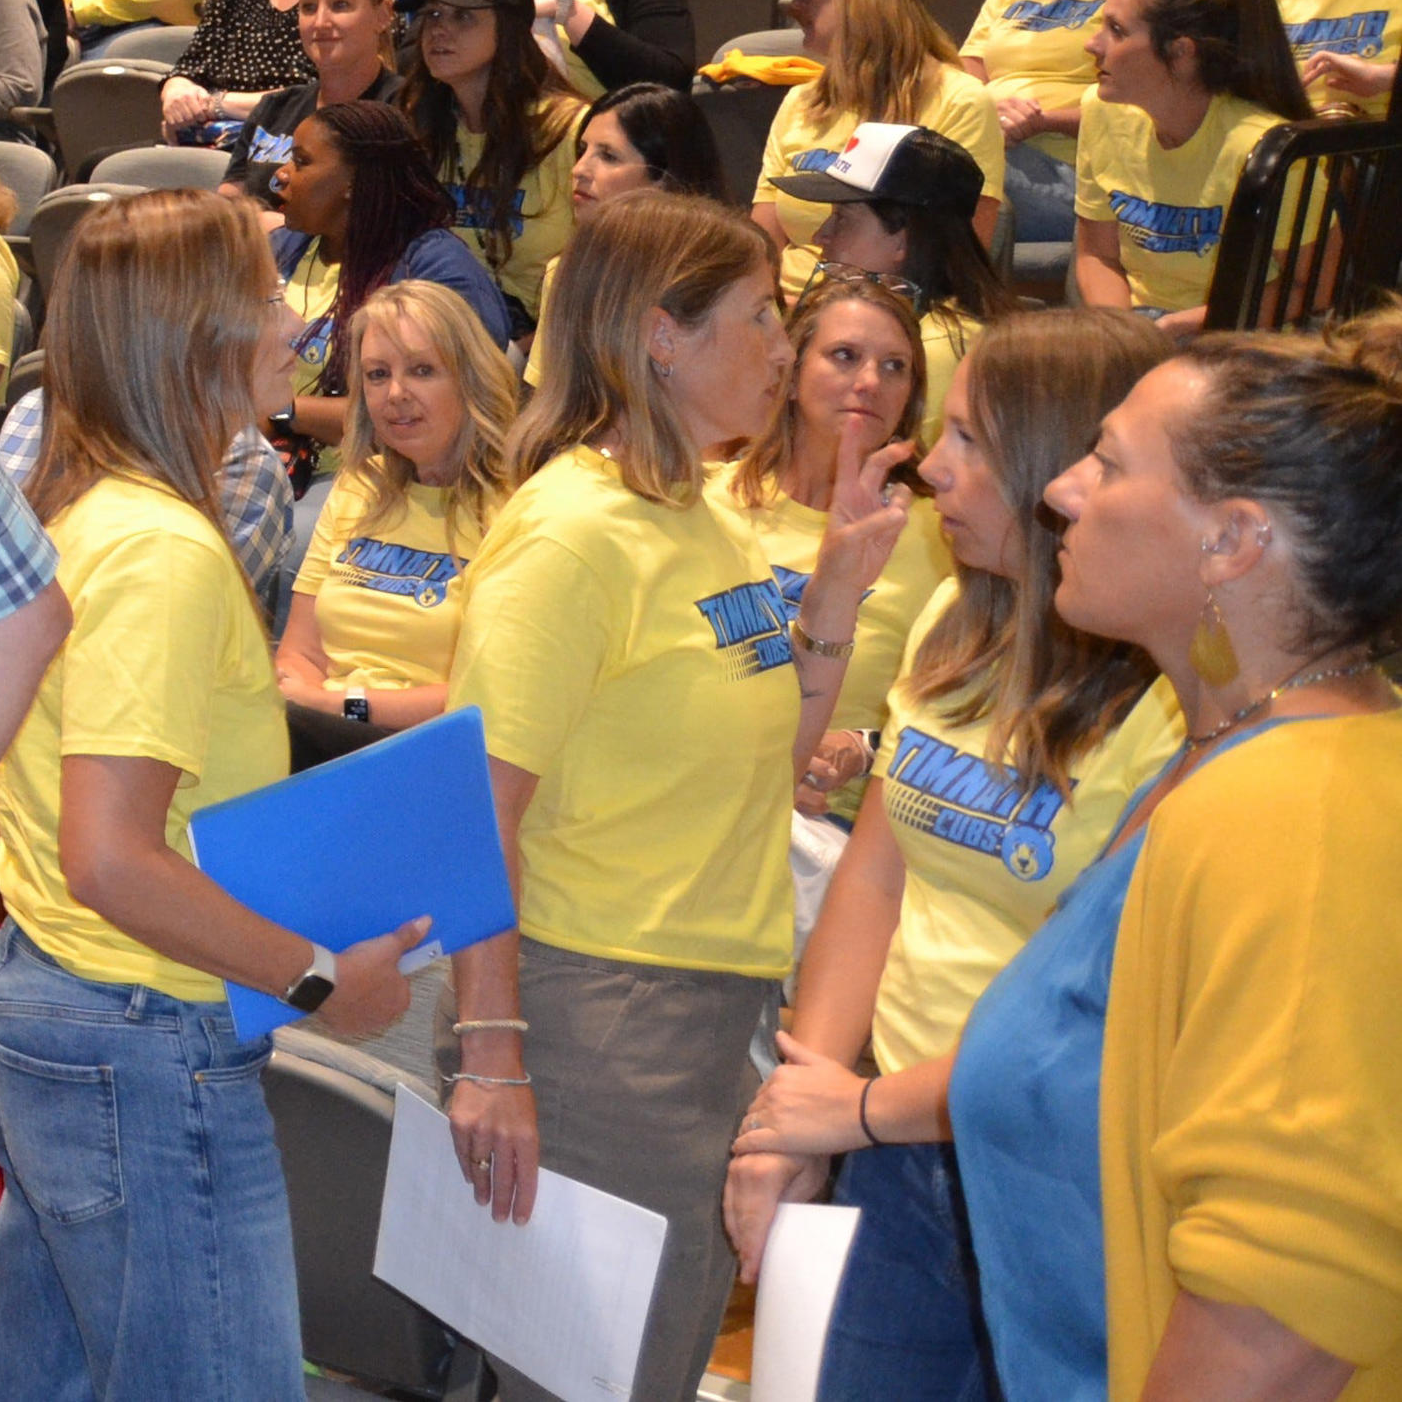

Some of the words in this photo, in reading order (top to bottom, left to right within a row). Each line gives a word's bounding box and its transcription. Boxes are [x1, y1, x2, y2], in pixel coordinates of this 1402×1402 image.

[1109, 190, 1223, 235] TIMNATH
[336, 538, 470, 581] TIMNATH
[694, 579, 789, 649] TIMNATH
[932, 807, 1004, 858] CUBS
